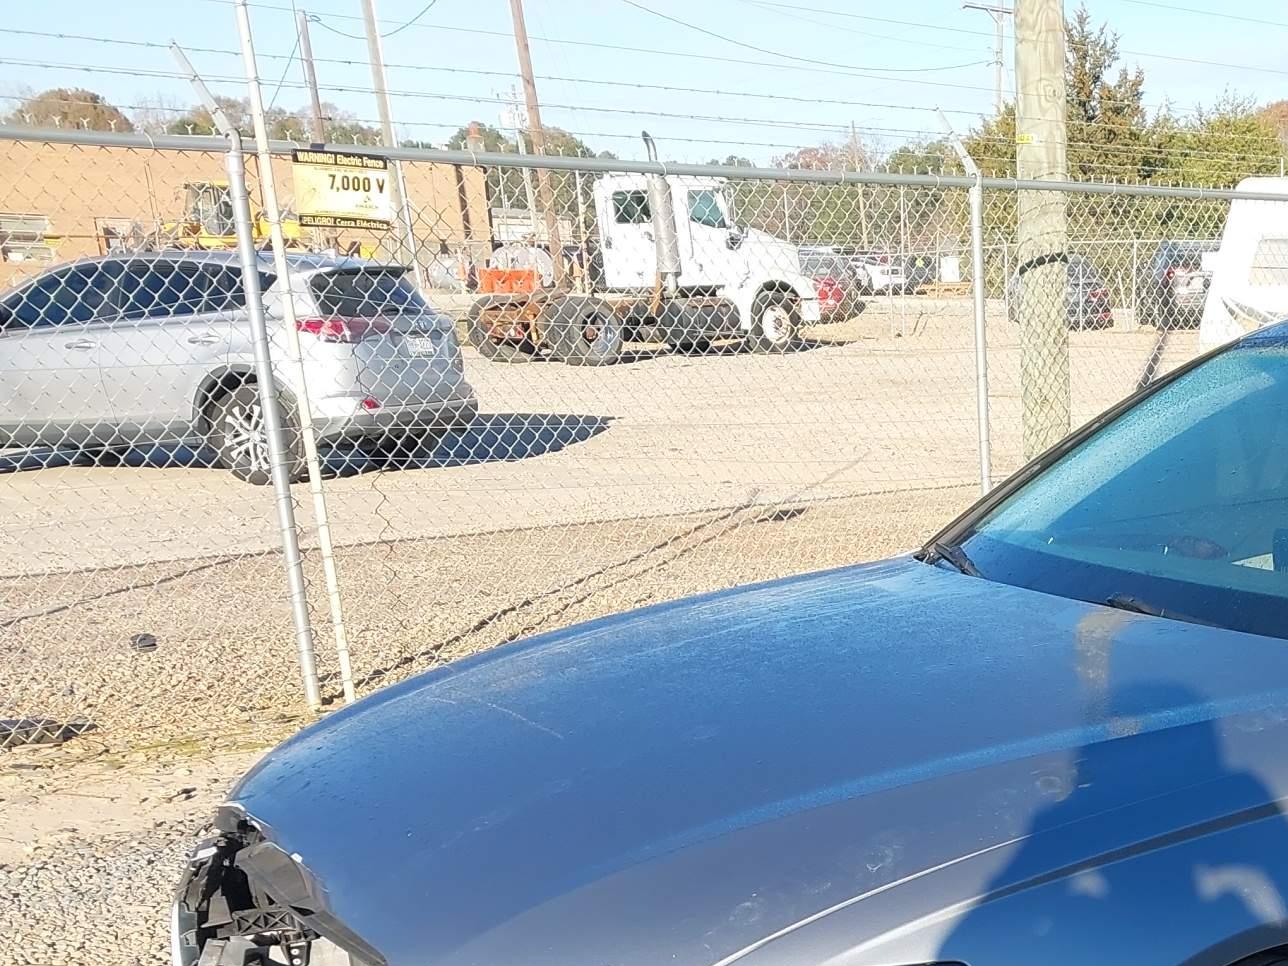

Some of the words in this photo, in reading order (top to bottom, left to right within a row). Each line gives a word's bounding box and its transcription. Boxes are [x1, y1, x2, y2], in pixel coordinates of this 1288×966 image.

[297, 152, 335, 164] WARNING!
[337, 155, 362, 166] Electric
[363, 157, 384, 168] Fence
[328, 174, 371, 192] 7,000
[376, 178, 385, 194] V
